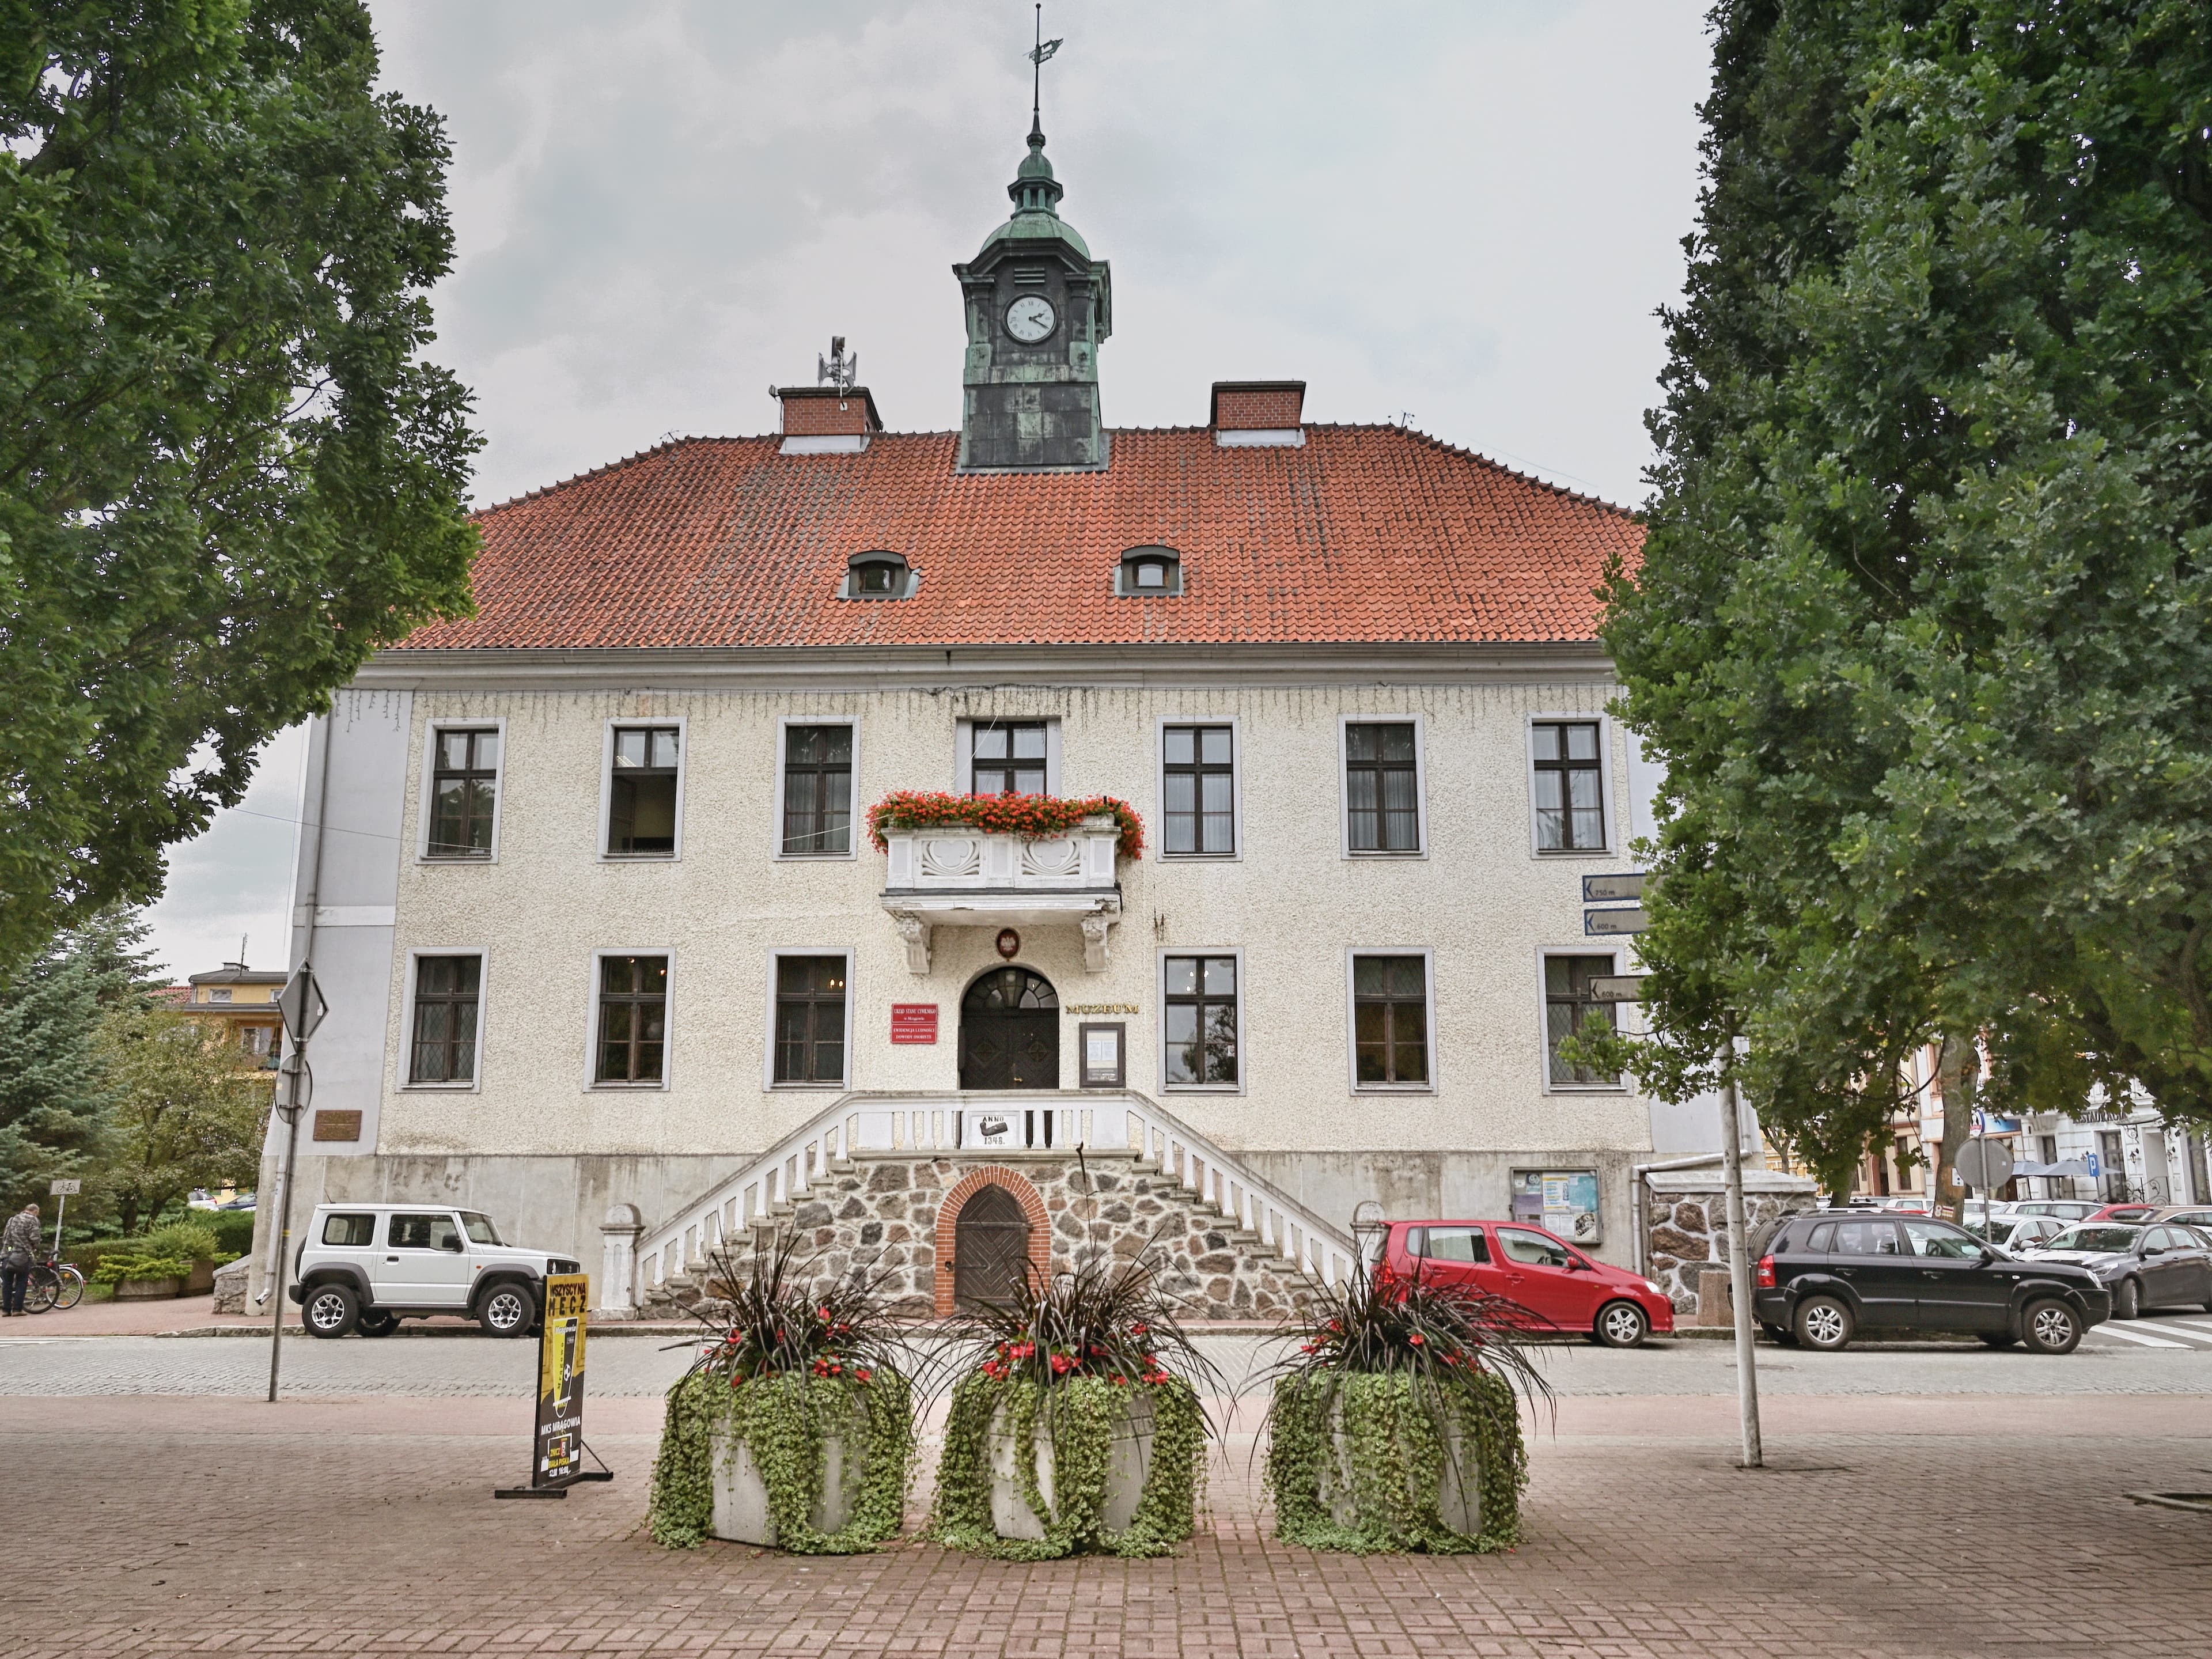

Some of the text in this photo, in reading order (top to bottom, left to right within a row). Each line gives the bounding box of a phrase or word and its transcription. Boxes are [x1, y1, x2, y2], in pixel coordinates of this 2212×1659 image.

[1066, 1004, 1139, 1014] MUZEUM
[2089, 1157, 2096, 1175] P
[550, 1282, 586, 1297] WSZYSCY NA
[548, 1295, 586, 1317] MECZ
[541, 1423, 552, 1435] MKS
